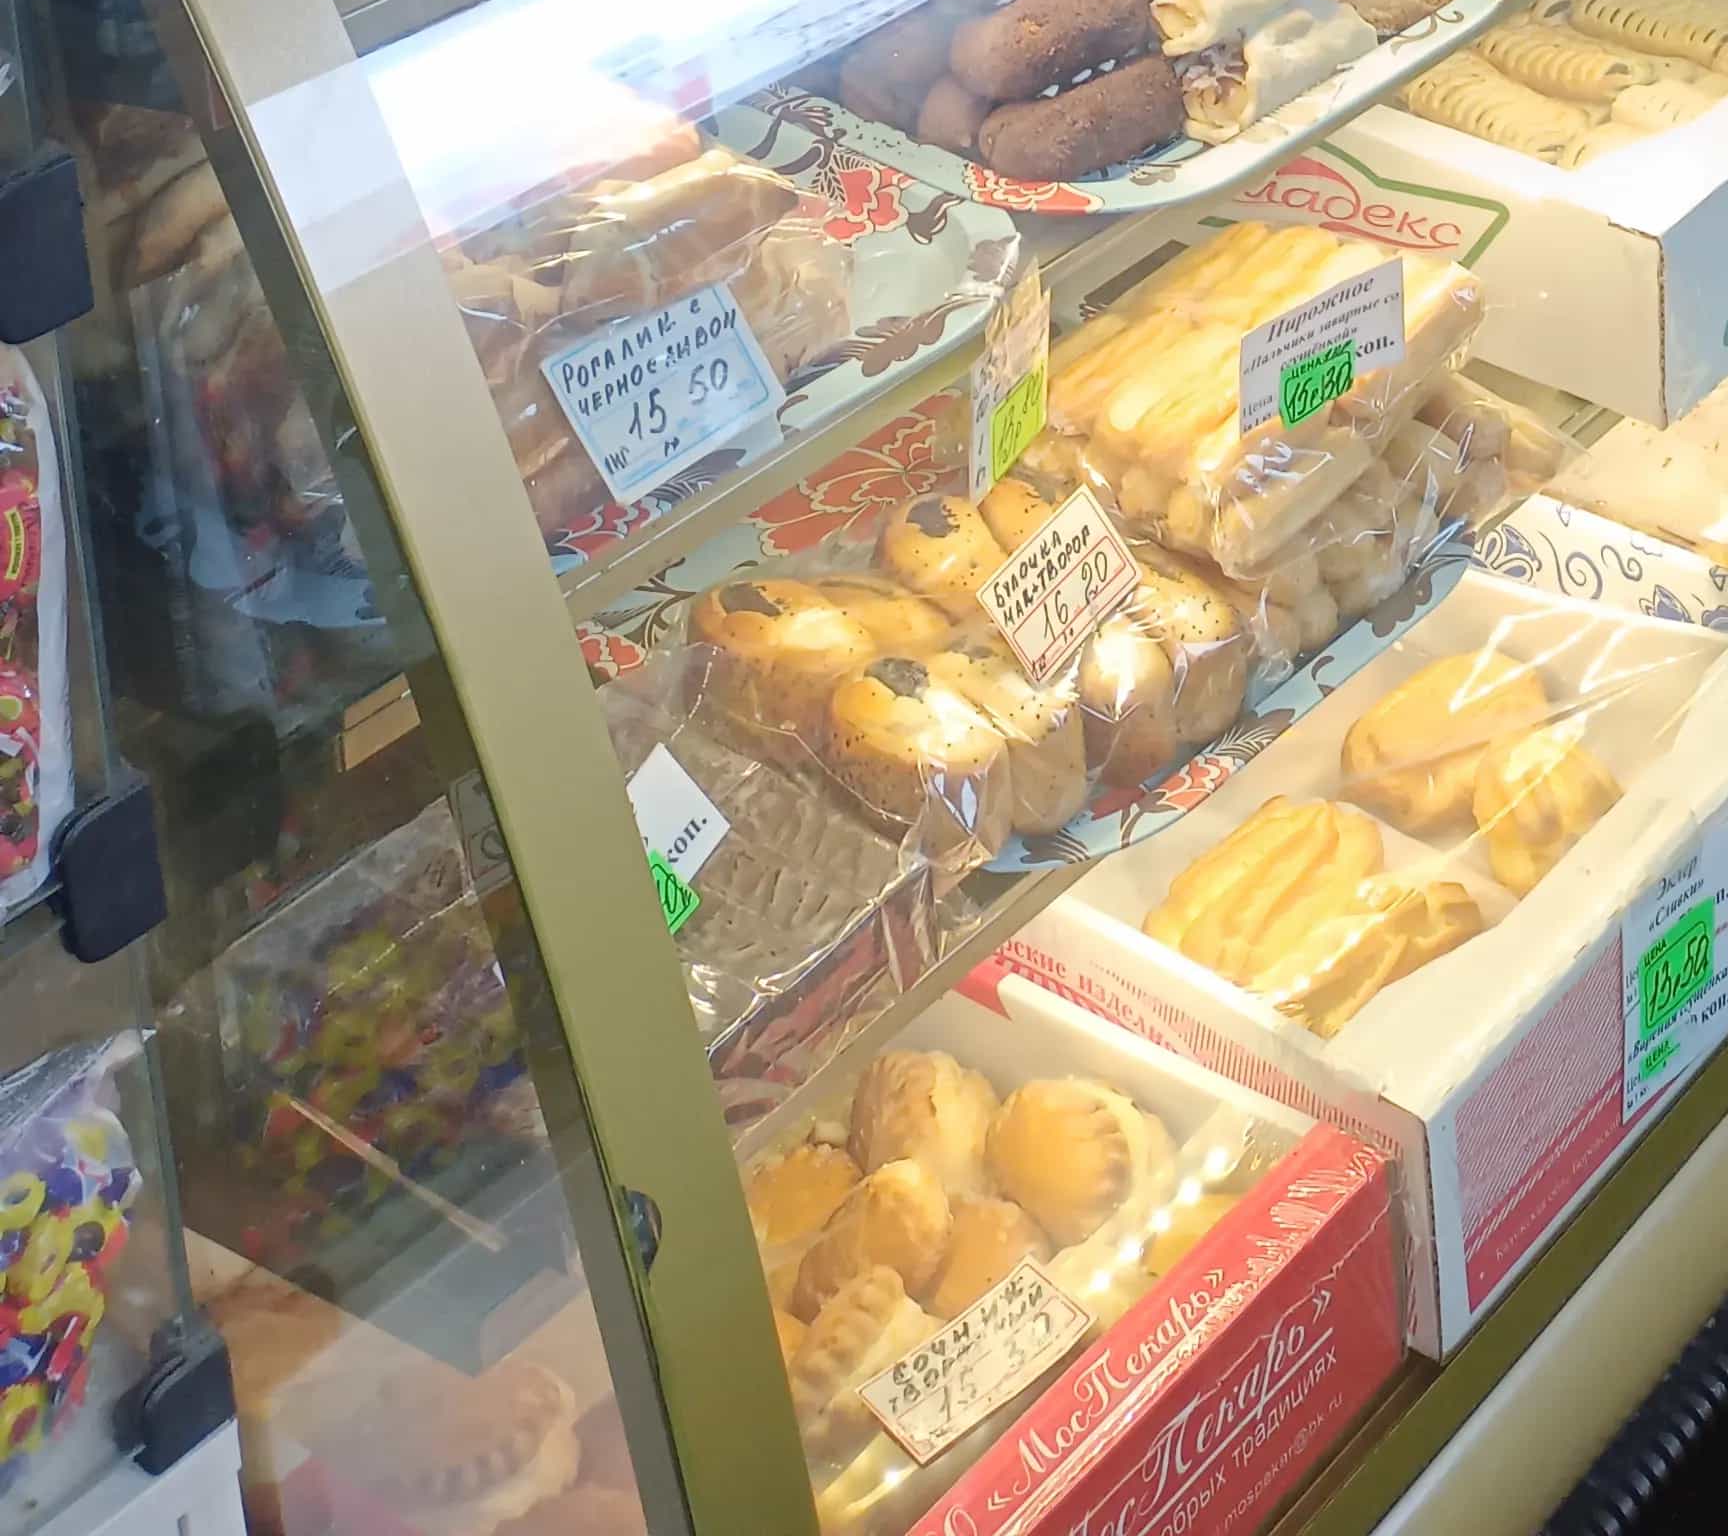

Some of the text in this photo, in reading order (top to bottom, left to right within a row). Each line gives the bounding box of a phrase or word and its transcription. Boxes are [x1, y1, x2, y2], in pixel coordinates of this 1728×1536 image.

[1235, 166, 1463, 253] ладекс
[1266, 277, 1375, 344] Пирожное
[562, 310, 677, 395] РОГАЛИК
[1291, 359, 1322, 379] ЦЕНА
[995, 529, 1062, 610] БУЛОЧКА
[1643, 940, 1667, 967] ЦЕНА
[1645, 1038, 1672, 1069] ЦЕНА
[1231, 1345, 1338, 1469] традициях
